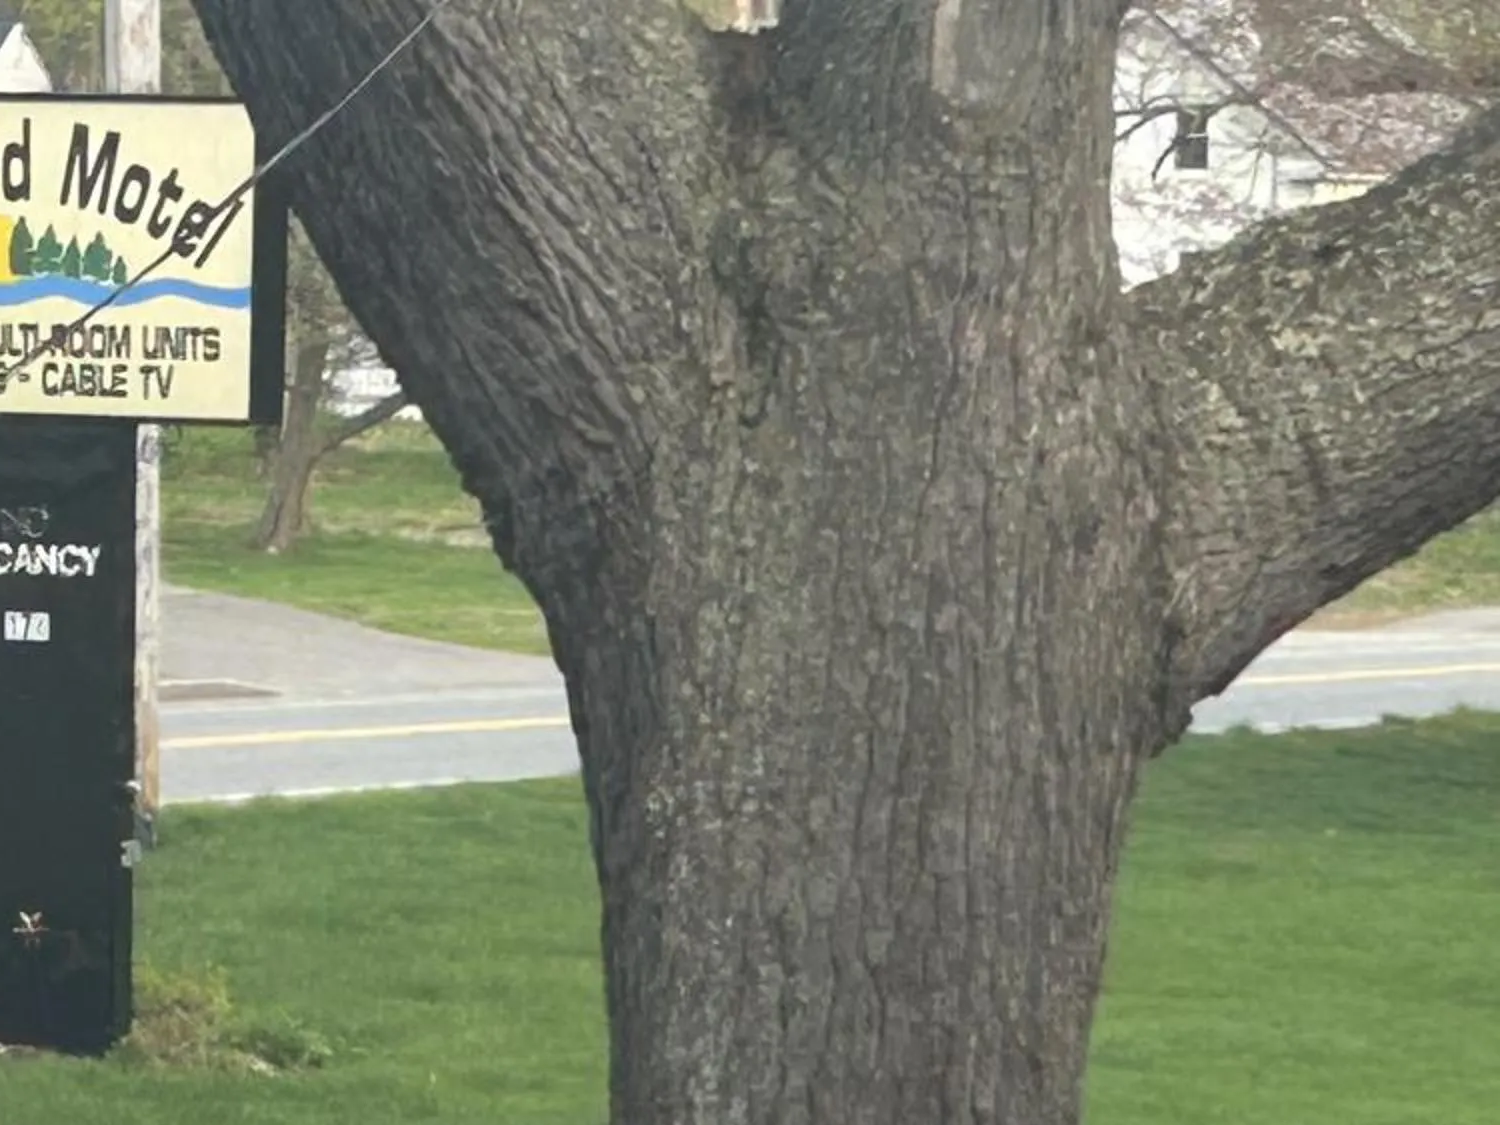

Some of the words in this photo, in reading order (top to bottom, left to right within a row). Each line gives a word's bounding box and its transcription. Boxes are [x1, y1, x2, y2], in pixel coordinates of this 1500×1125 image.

[61, 122, 243, 268] Motel
[142, 326, 221, 362] UNITS
[41, 364, 128, 397] CABLE
[138, 365, 173, 399] TV
